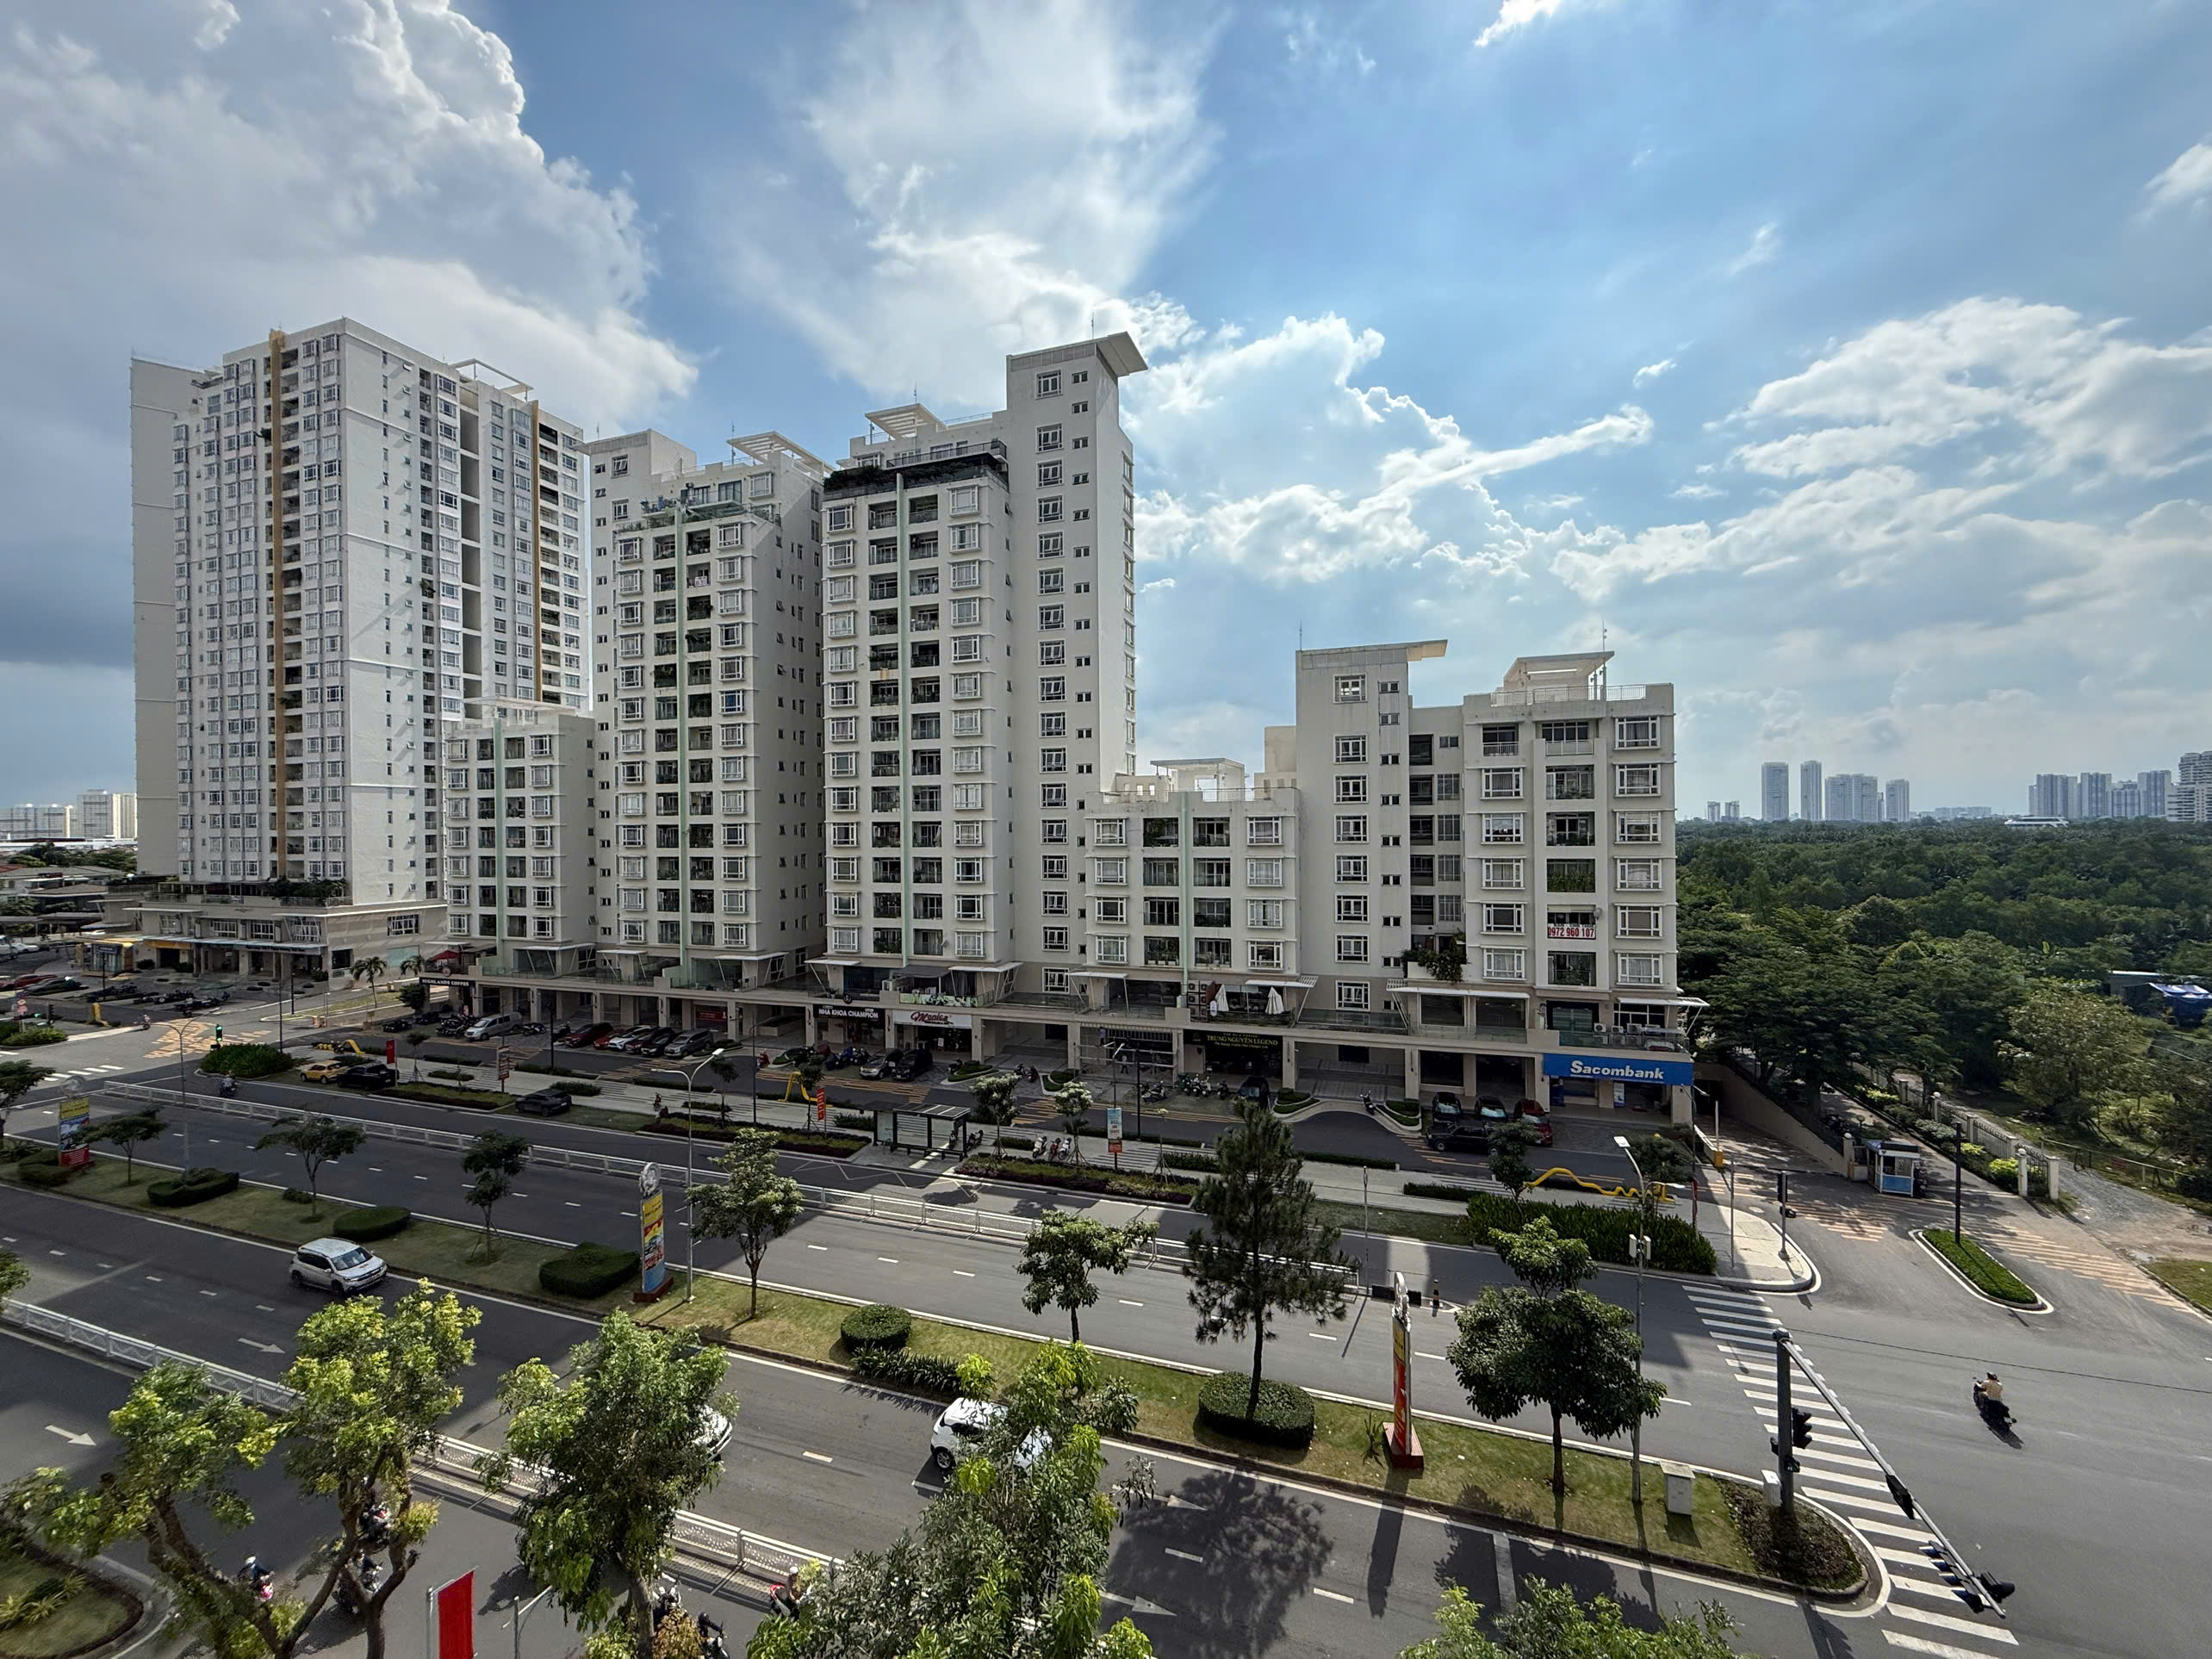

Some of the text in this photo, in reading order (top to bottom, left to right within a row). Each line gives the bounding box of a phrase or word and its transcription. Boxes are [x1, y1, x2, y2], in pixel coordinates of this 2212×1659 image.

[1548, 927, 1594, 937] 0972 960 107
[1570, 1060, 1664, 1079] Sacombank
